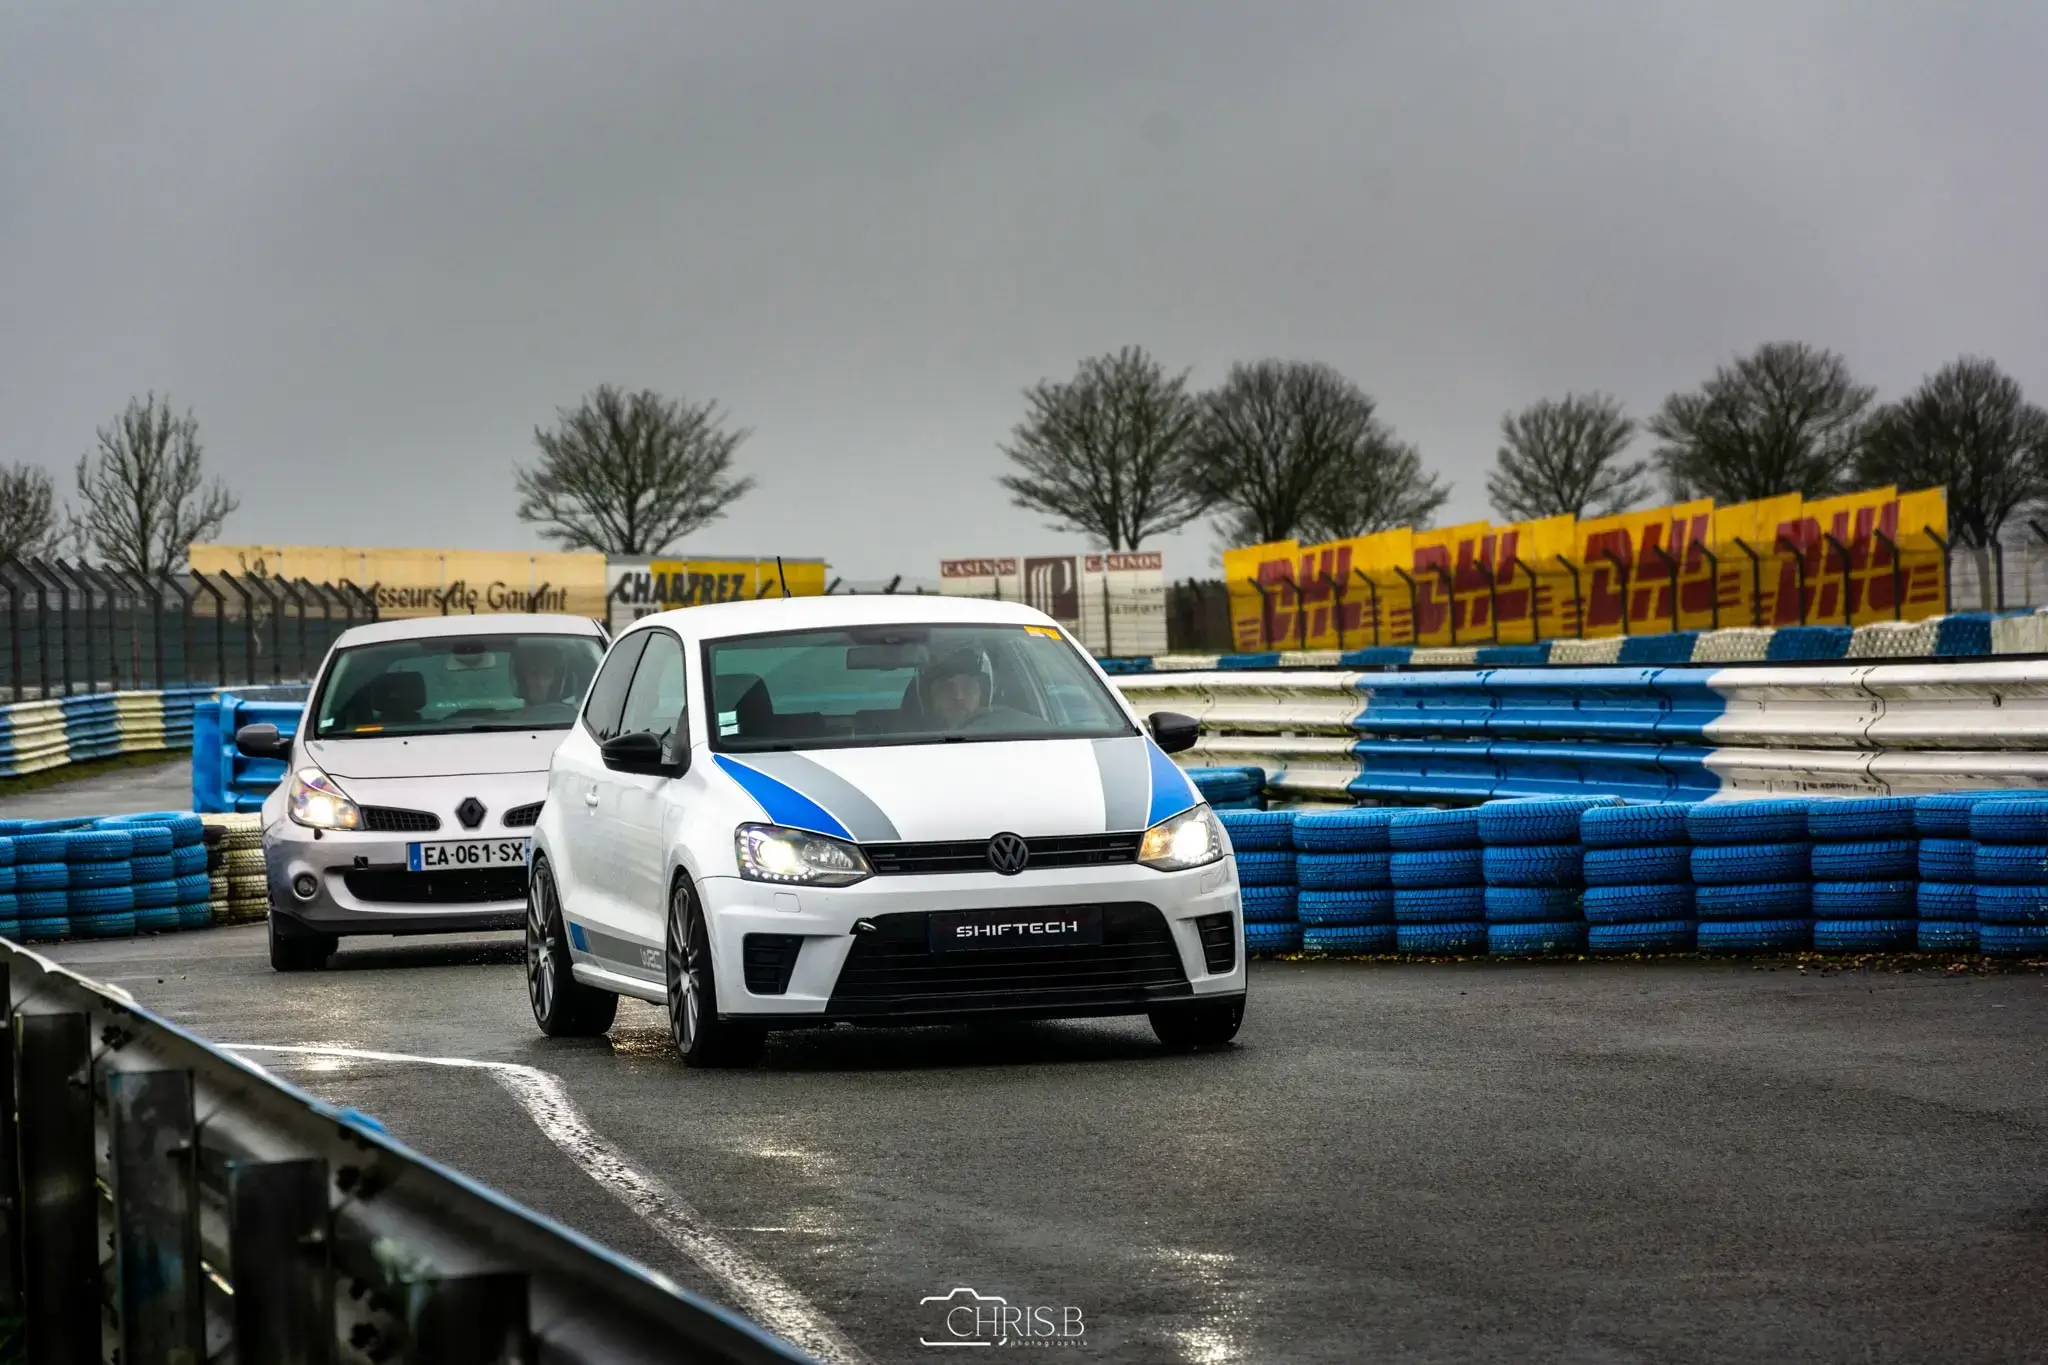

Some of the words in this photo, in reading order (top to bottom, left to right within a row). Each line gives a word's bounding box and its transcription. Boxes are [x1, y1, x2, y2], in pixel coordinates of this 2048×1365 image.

[1086, 555, 1160, 571] CSINOS
[1258, 545, 1362, 643] DHL
[1413, 531, 1531, 634] DHL
[1584, 514, 1714, 628] DHL
[1774, 501, 1911, 626] DHL
[424, 842, 523, 866] EA-061-SX
[956, 921, 1078, 938] SHIFTECH
